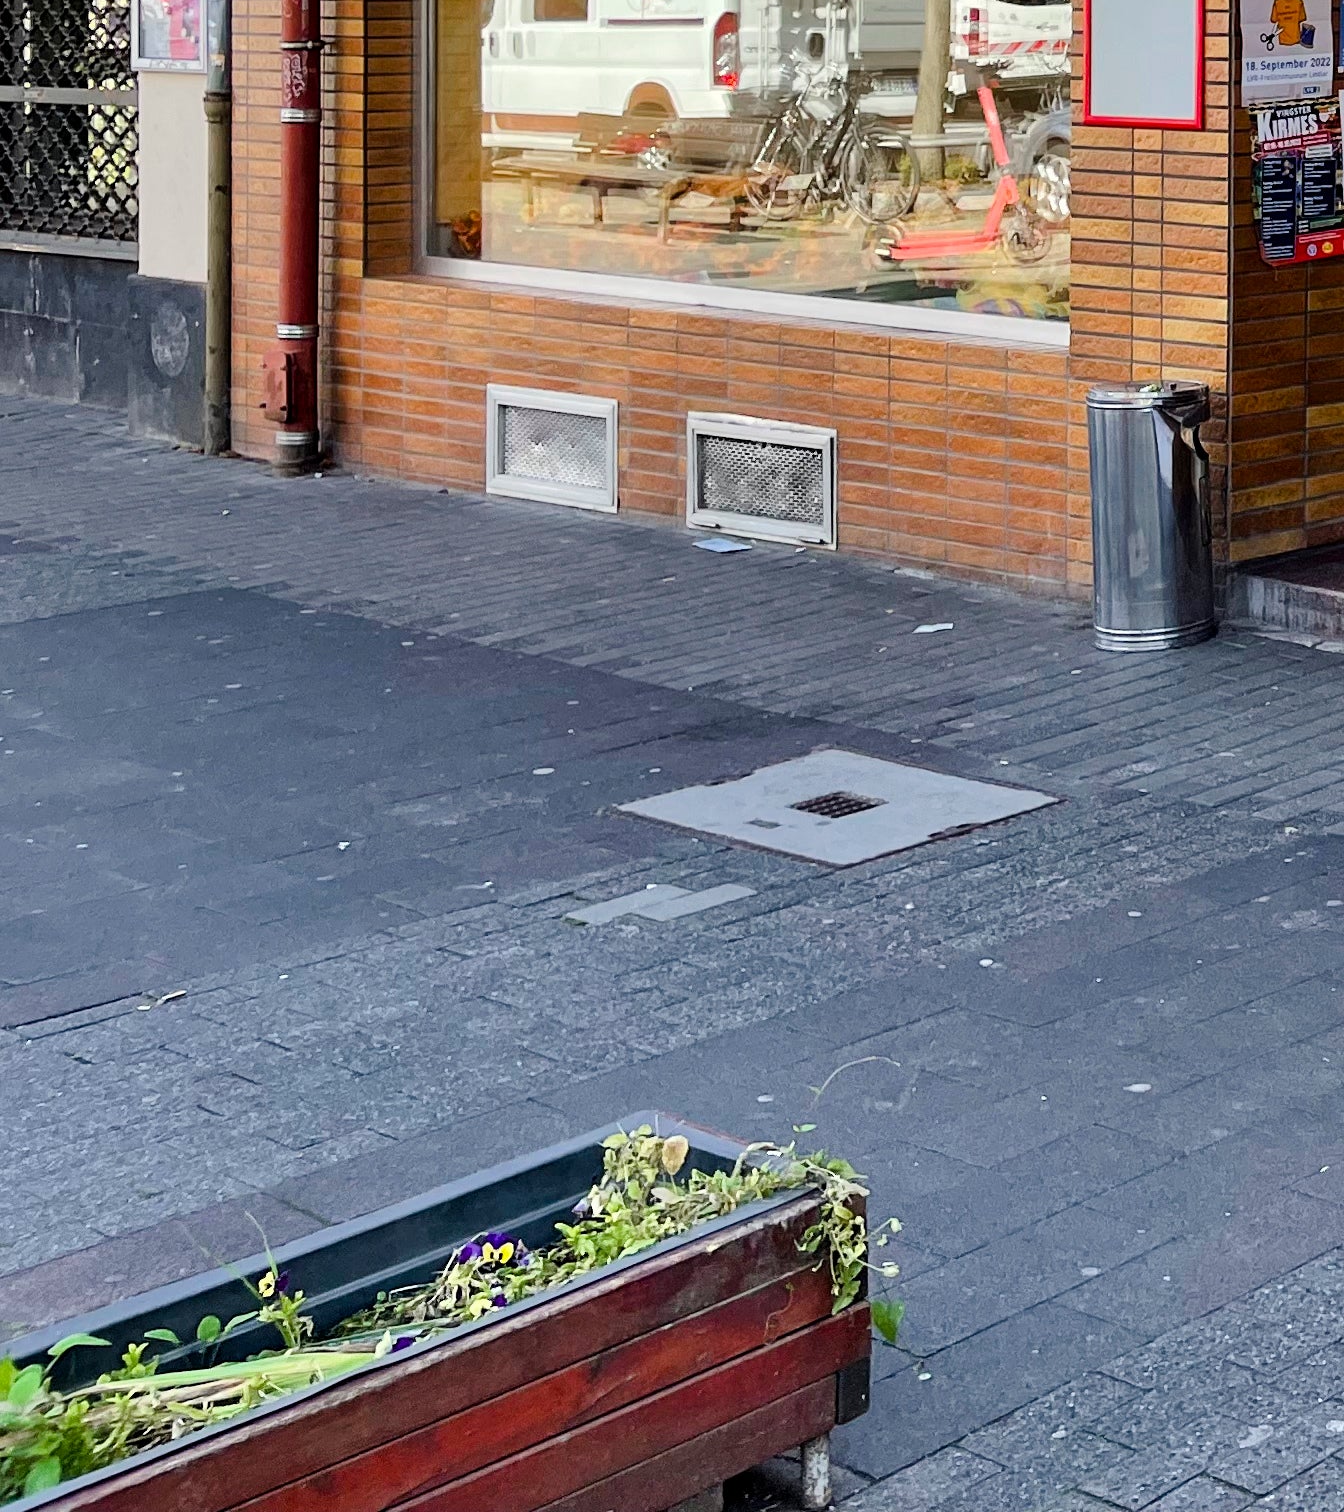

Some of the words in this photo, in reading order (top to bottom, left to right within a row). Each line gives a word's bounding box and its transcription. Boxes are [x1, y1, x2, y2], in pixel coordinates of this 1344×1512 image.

[1260, 58, 1308, 72] September
[1310, 57, 1331, 68] 2022
[1256, 111, 1319, 143] KIRMES
